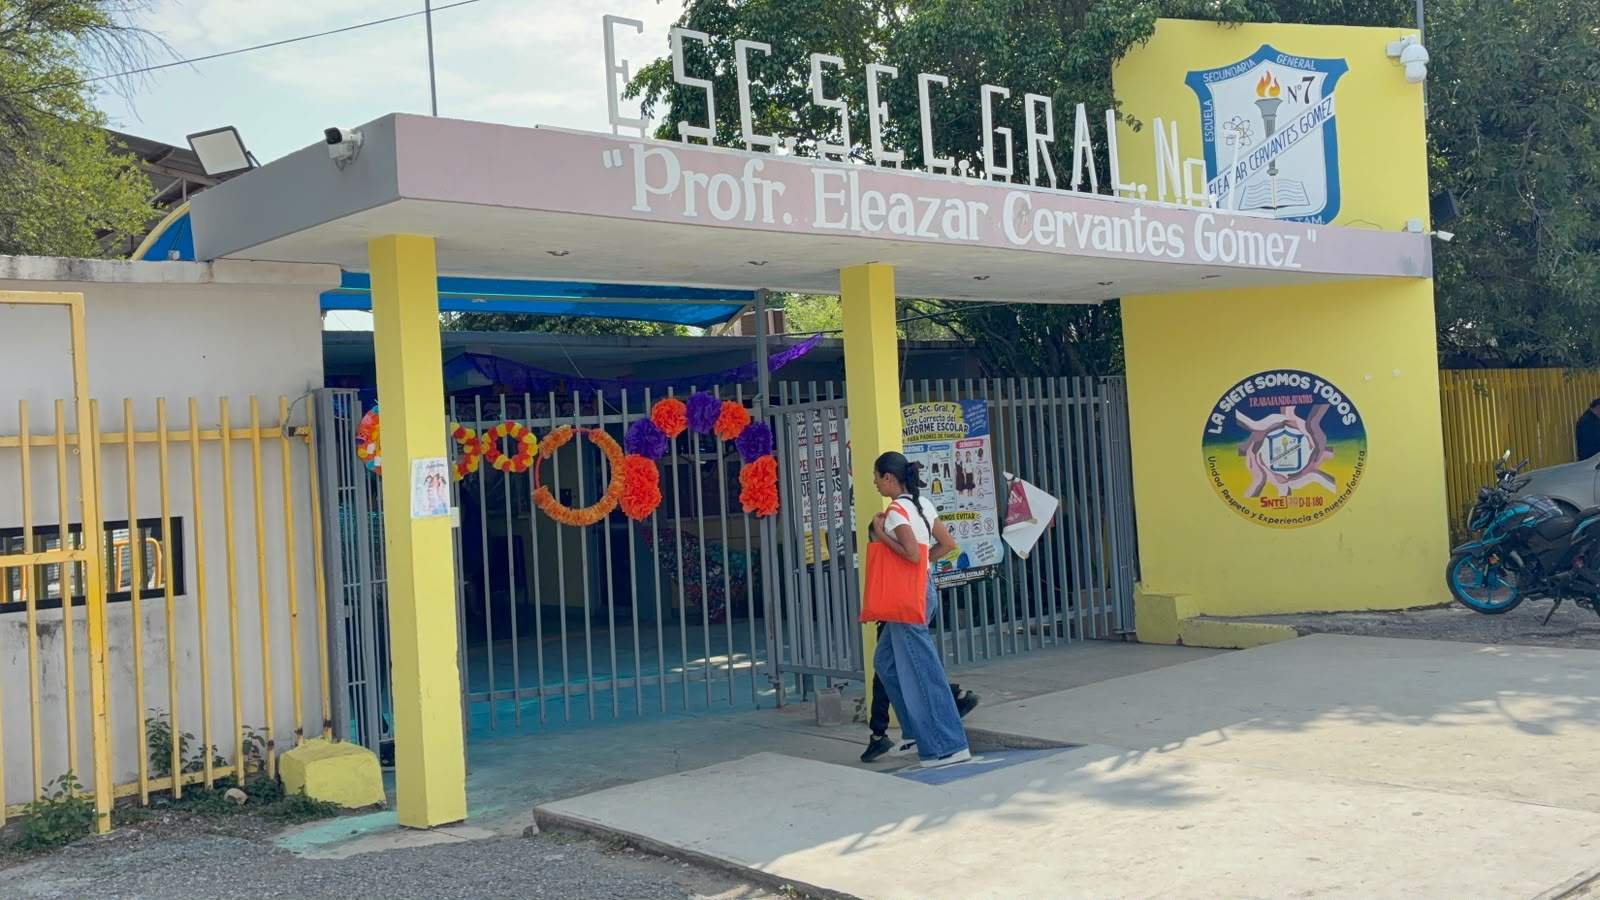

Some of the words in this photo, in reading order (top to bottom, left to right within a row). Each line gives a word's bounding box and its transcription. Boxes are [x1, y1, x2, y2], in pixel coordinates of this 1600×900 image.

[1202, 58, 1257, 83] SECUNDARIA
[1276, 53, 1316, 71] GENERAL
[603, 15, 796, 152] ESC.
[810, 52, 969, 174] SEC.
[981, 84, 1147, 198] GRAL.
[1204, 99, 1215, 142] ESCUELA
[1209, 161, 1247, 197] ELEAAR
[1249, 124, 1298, 170] CERVANTES
[1300, 97, 1333, 134] GOMEZ
[811, 168, 988, 242] Eleazar
[1002, 190, 1185, 259] Cervantes
[903, 408, 917, 418] Esc.
[918, 404, 933, 414] Sec.
[934, 403, 950, 413] Gral.
[951, 404, 956, 413] 7
[905, 417, 917, 427] Uso
[918, 414, 946, 424] Correcto
[946, 414, 956, 422] del
[1207, 412, 1226, 435] LA
[1219, 379, 1256, 412] SIETE
[1254, 372, 1311, 390] SOMOS
[1312, 379, 1357, 426] TODOS
[902, 422, 935, 437] NIFORME
[936, 422, 969, 433] ESCOLAR
[1207, 455, 1224, 488] Unidad
[1221, 489, 1251, 514] Respeto
[1257, 513, 1312, 525] Experiencia
[1313, 510, 1325, 519] es
[955, 512, 976, 520] EVITAR
